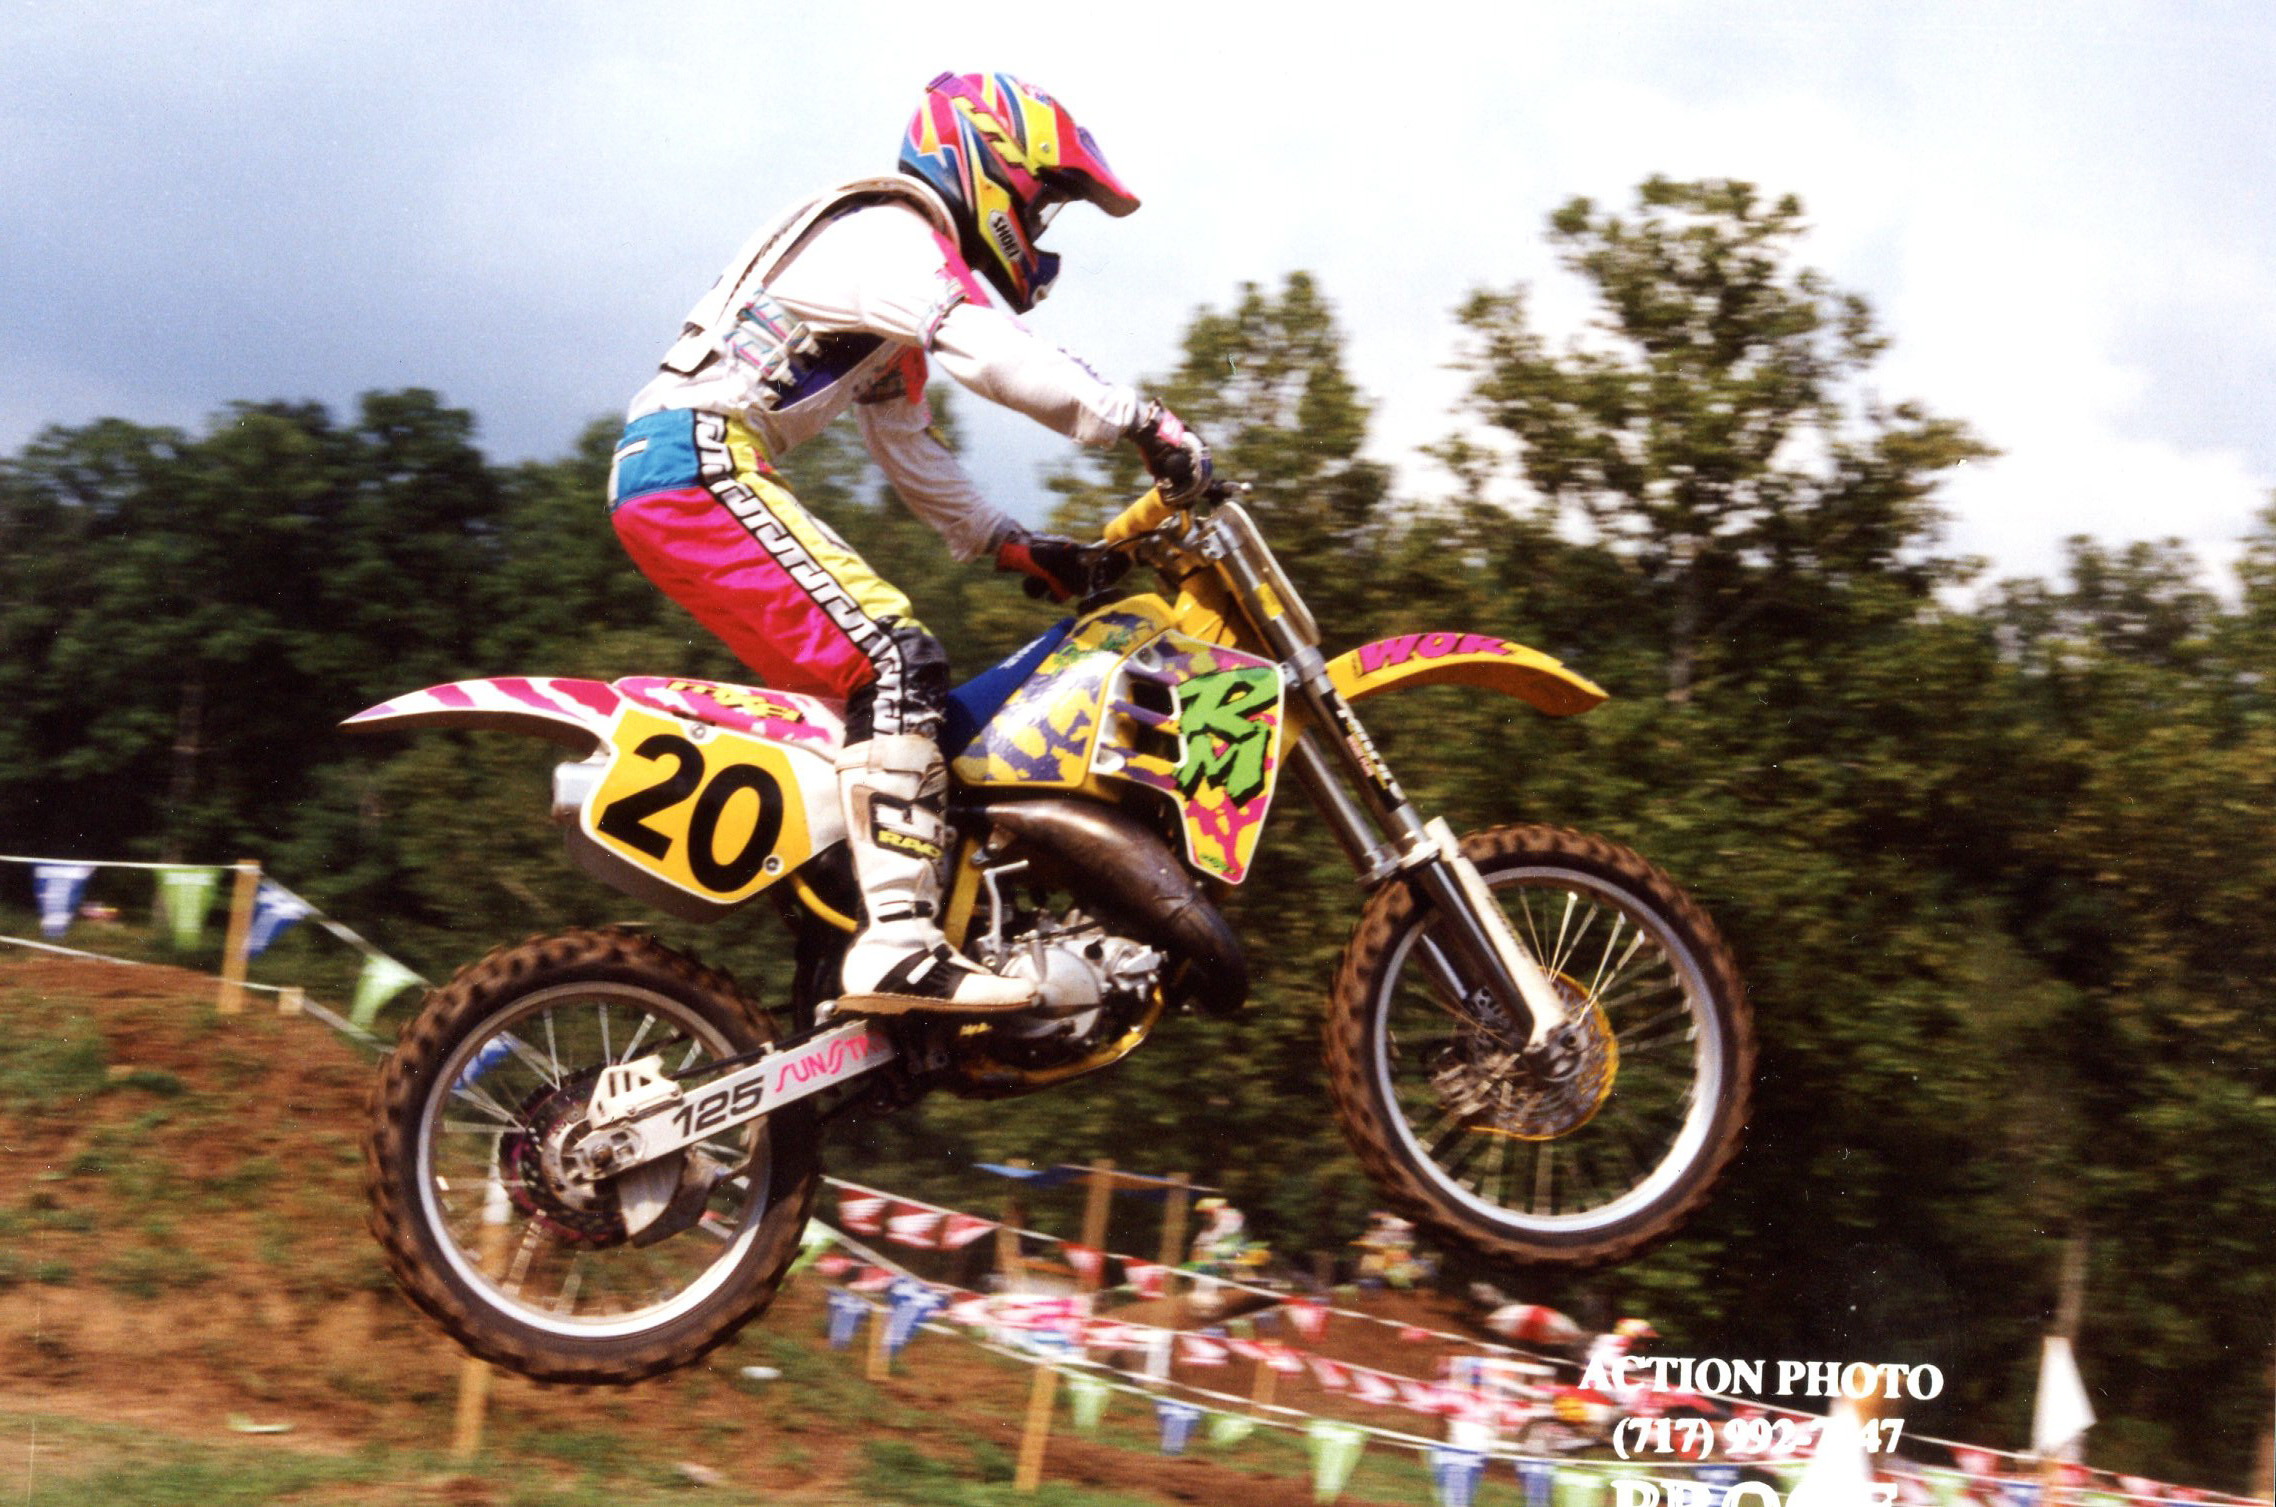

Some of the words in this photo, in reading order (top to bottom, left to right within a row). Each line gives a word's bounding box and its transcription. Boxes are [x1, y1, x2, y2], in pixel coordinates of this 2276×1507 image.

[992, 215, 1021, 259] SHOEI
[596, 733, 784, 893] 20
[672, 1075, 766, 1138] 125
